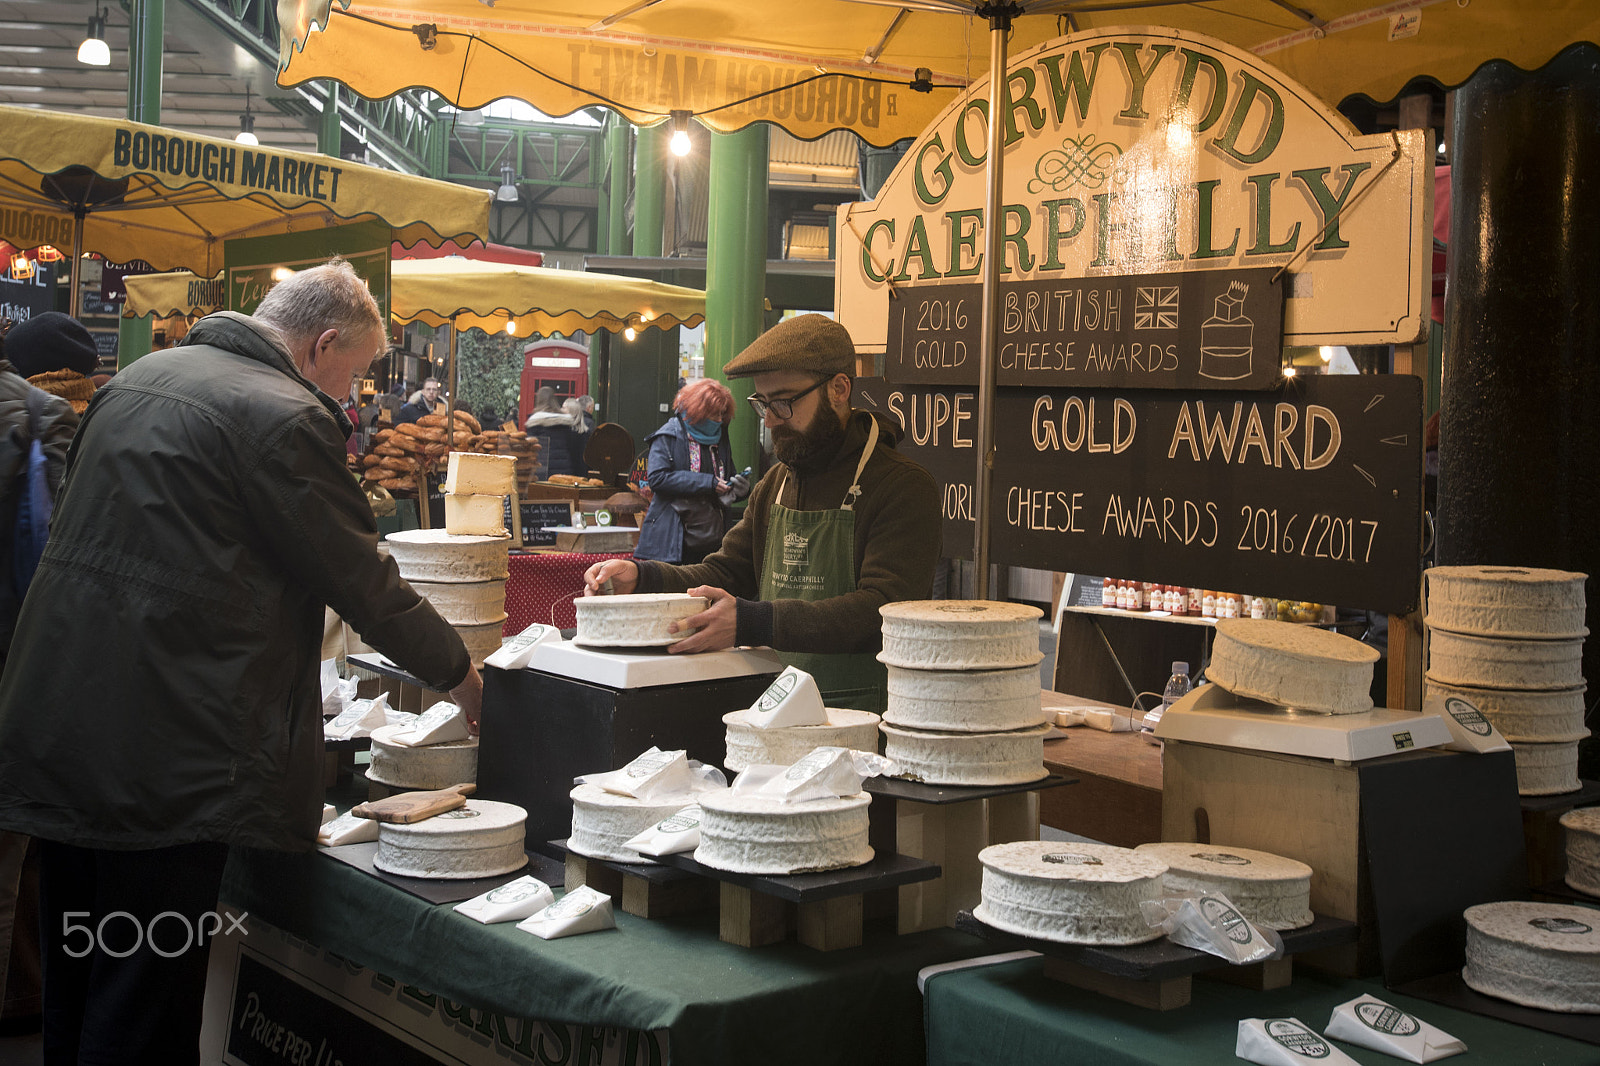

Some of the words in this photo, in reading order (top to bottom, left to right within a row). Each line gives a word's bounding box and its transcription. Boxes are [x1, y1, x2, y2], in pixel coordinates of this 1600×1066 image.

[914, 42, 1285, 205] GORWYDD
[113, 128, 236, 186] BOROUGH
[241, 150, 343, 203] MARKET
[862, 162, 1371, 284] CAERPHILLY
[916, 299, 968, 333] 2016
[1004, 288, 1122, 336] BRITISH
[914, 339, 967, 369] GOLD
[999, 342, 1078, 372] CHEESE
[1086, 342, 1180, 373] AWARDS
[887, 391, 974, 448] SUPE
[1031, 395, 1137, 455] GOLD
[1169, 401, 1342, 470] AWARD
[942, 483, 976, 521] ORL
[1007, 486, 1085, 533] CHEESE
[1102, 494, 1218, 547] AWARDS
[1237, 505, 1379, 562] 2016/2017
[239, 991, 286, 1054] PRICE
